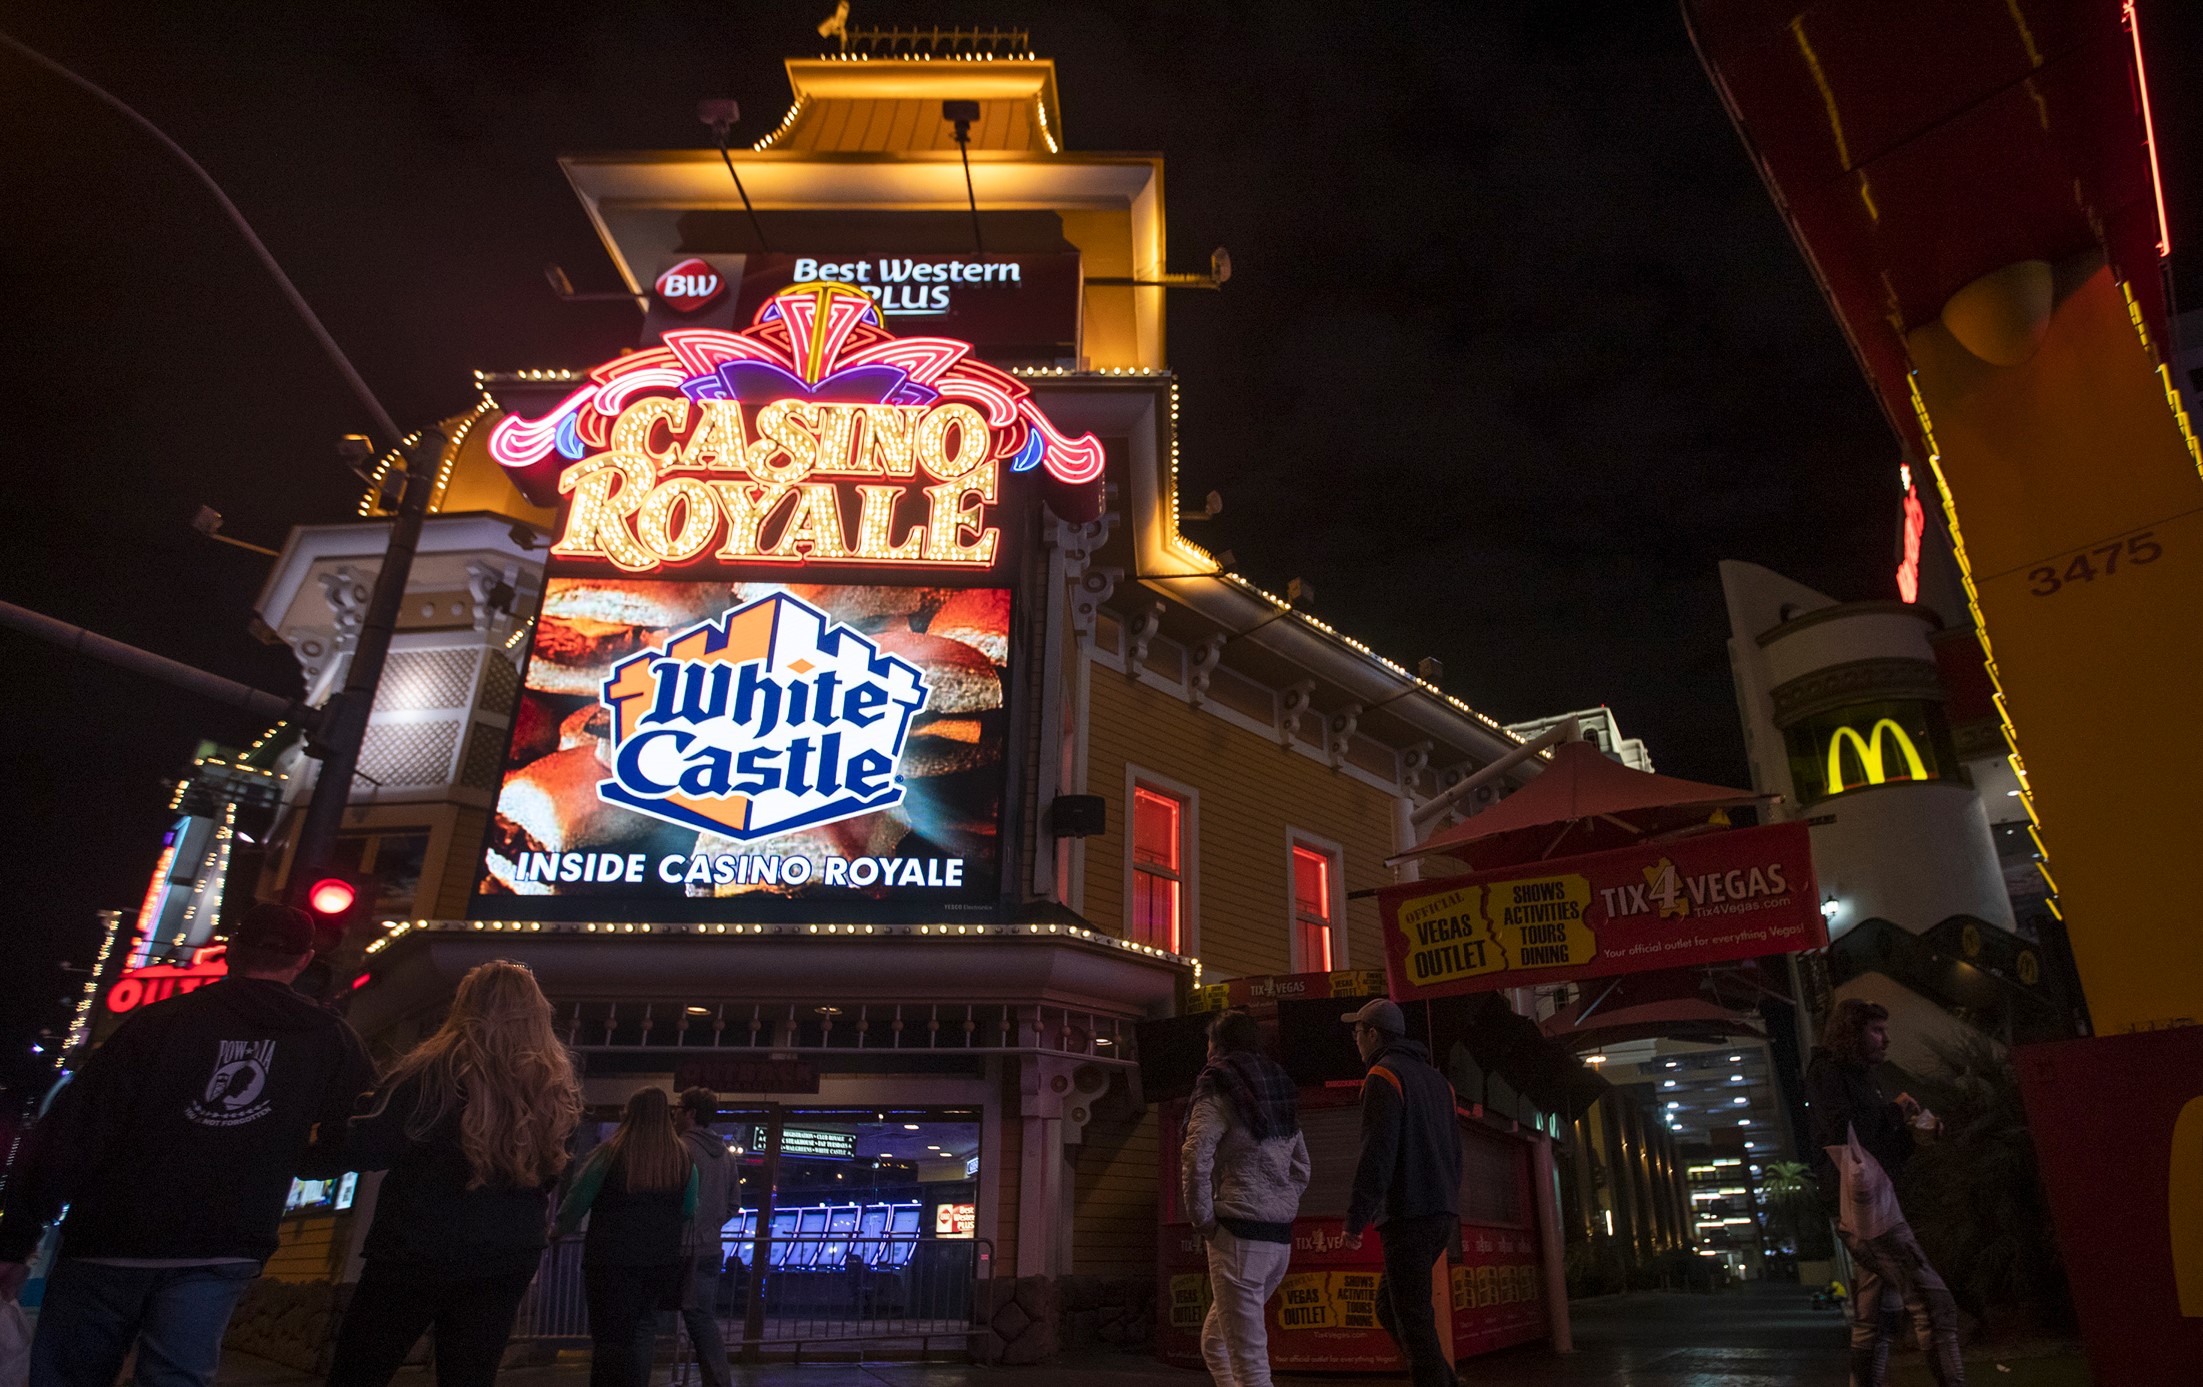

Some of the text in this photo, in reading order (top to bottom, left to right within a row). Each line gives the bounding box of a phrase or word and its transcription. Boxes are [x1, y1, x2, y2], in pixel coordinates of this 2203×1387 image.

[794, 258, 1020, 283] Best Western
[664, 275, 717, 297] BW
[861, 285, 950, 308] PLUS
[611, 396, 990, 486] CASINO
[550, 450, 999, 571] ROYALE
[2028, 531, 2163, 597] 3475
[640, 662, 889, 740] White
[616, 729, 893, 798] Castle
[515, 852, 964, 888] INSIDE CASINO ROYALE
[1513, 882, 1565, 904] SHOWS
[1405, 893, 1464, 924] OFFICIAL
[1504, 901, 1580, 925] ACTIVITIES
[1694, 897, 1791, 918] Tix4Vegas.com
[1416, 913, 1473, 945] VEGAS
[1520, 923, 1567, 945] TOURS
[1603, 923, 1805, 958] Your official outlet for everything Vegas!
[1415, 940, 1486, 979] OUTLET
[1521, 945, 1570, 966] DINING
[221, 1106, 272, 1127] FORGOTTEN
[1286, 1288, 1320, 1304] VEGAS
[1284, 1305, 1326, 1325] OUTLET
